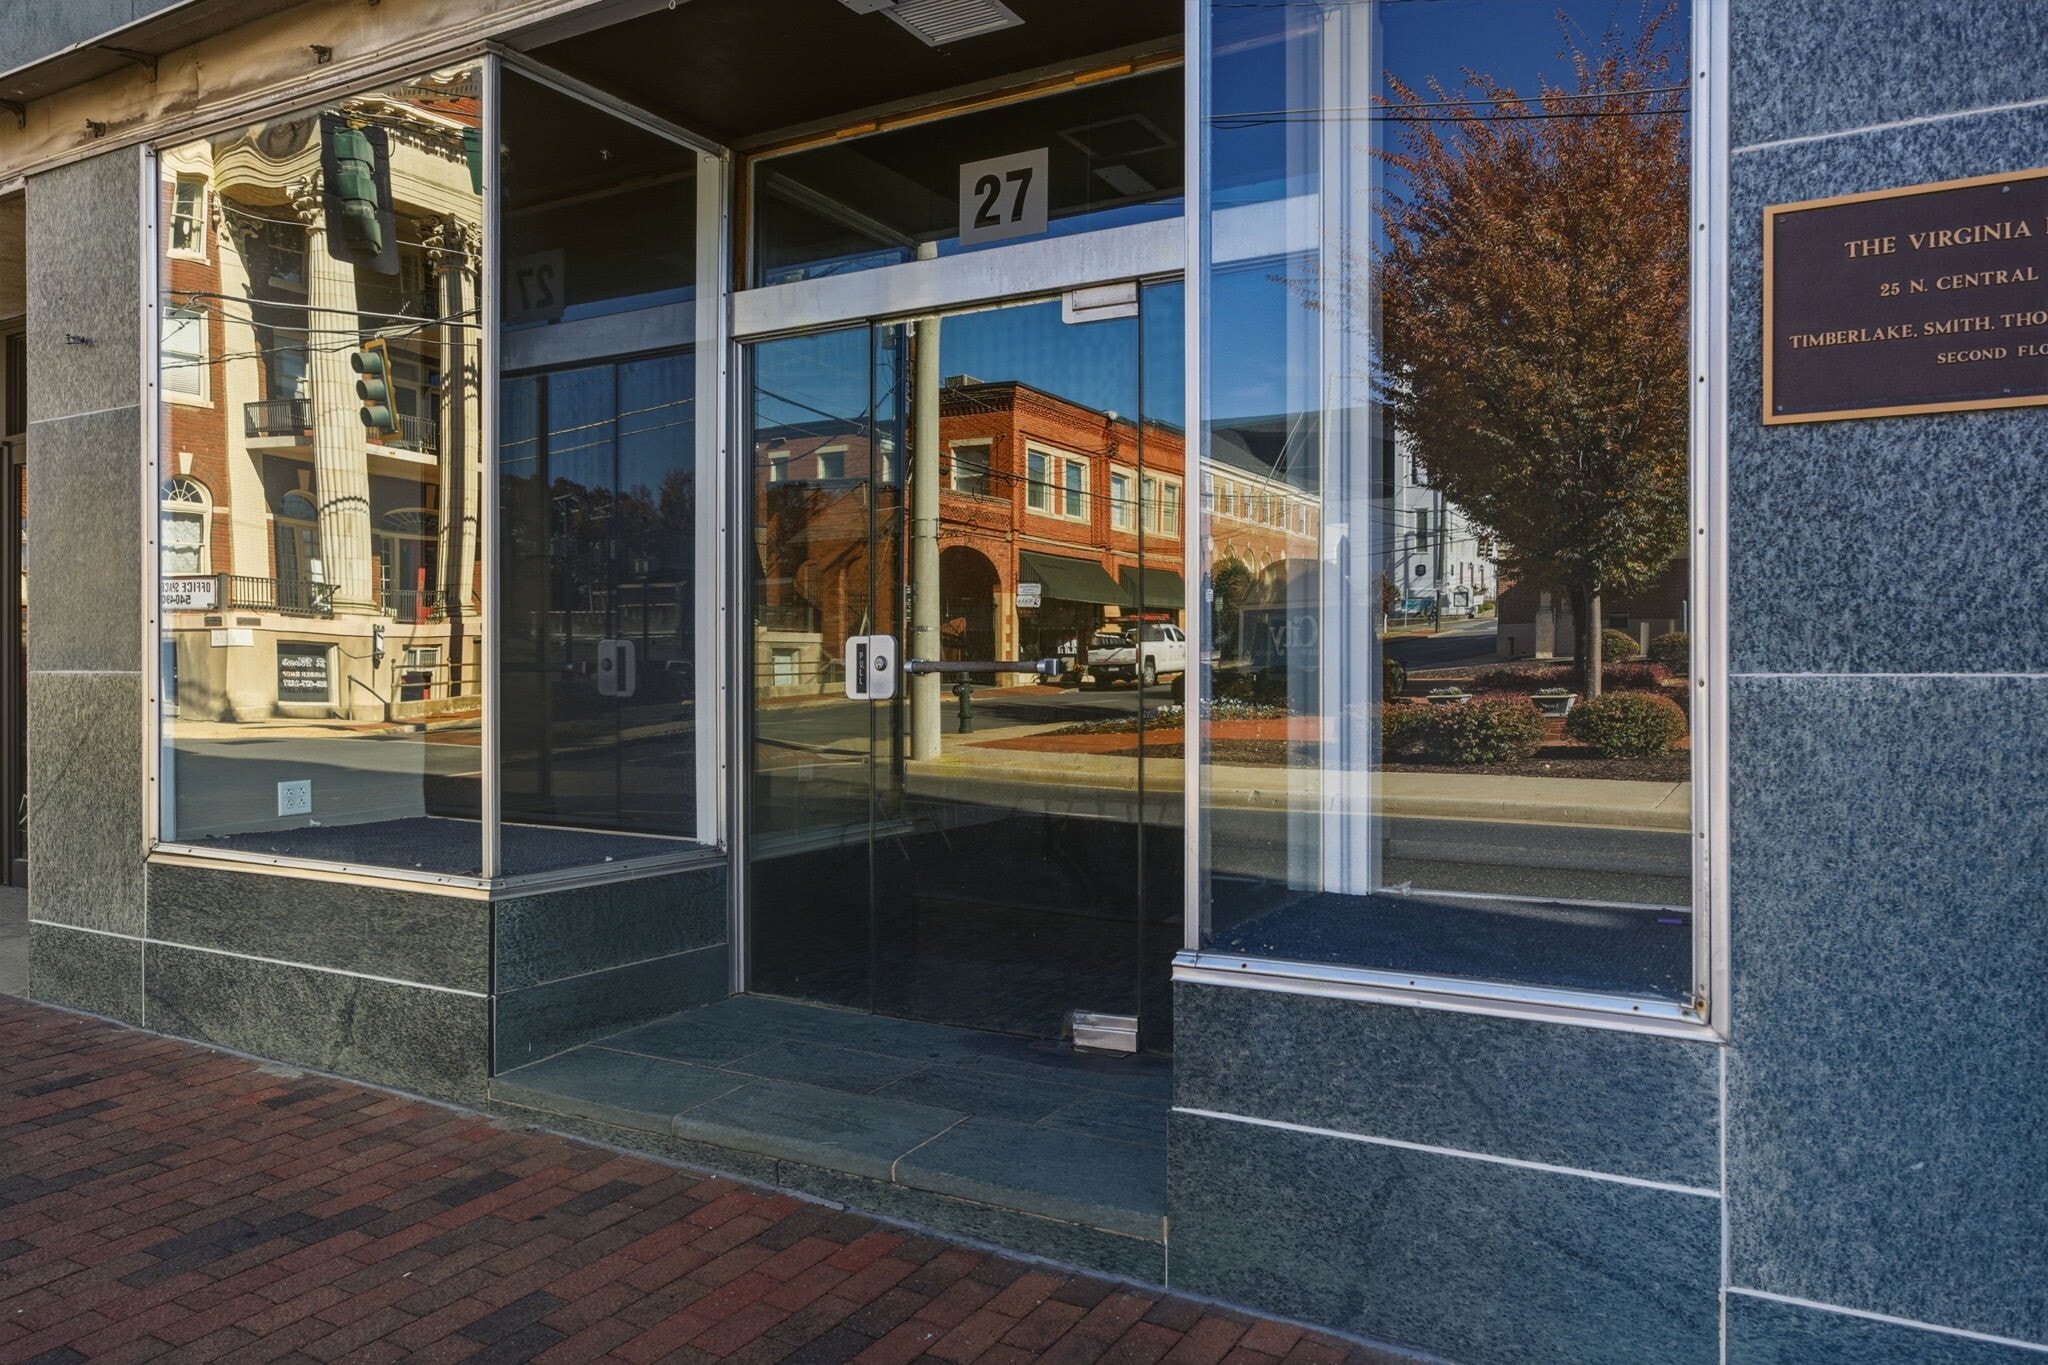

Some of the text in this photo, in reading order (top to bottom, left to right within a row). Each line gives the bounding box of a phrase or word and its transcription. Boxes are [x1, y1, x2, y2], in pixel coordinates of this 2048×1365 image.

[974, 167, 1033, 229] 27
[1844, 220, 2032, 259] THE VIRGINIA
[1880, 266, 2040, 297] 25 N. CENTRAL
[2000, 310, 2048, 328] THO
[1936, 347, 2008, 364] SECOND
